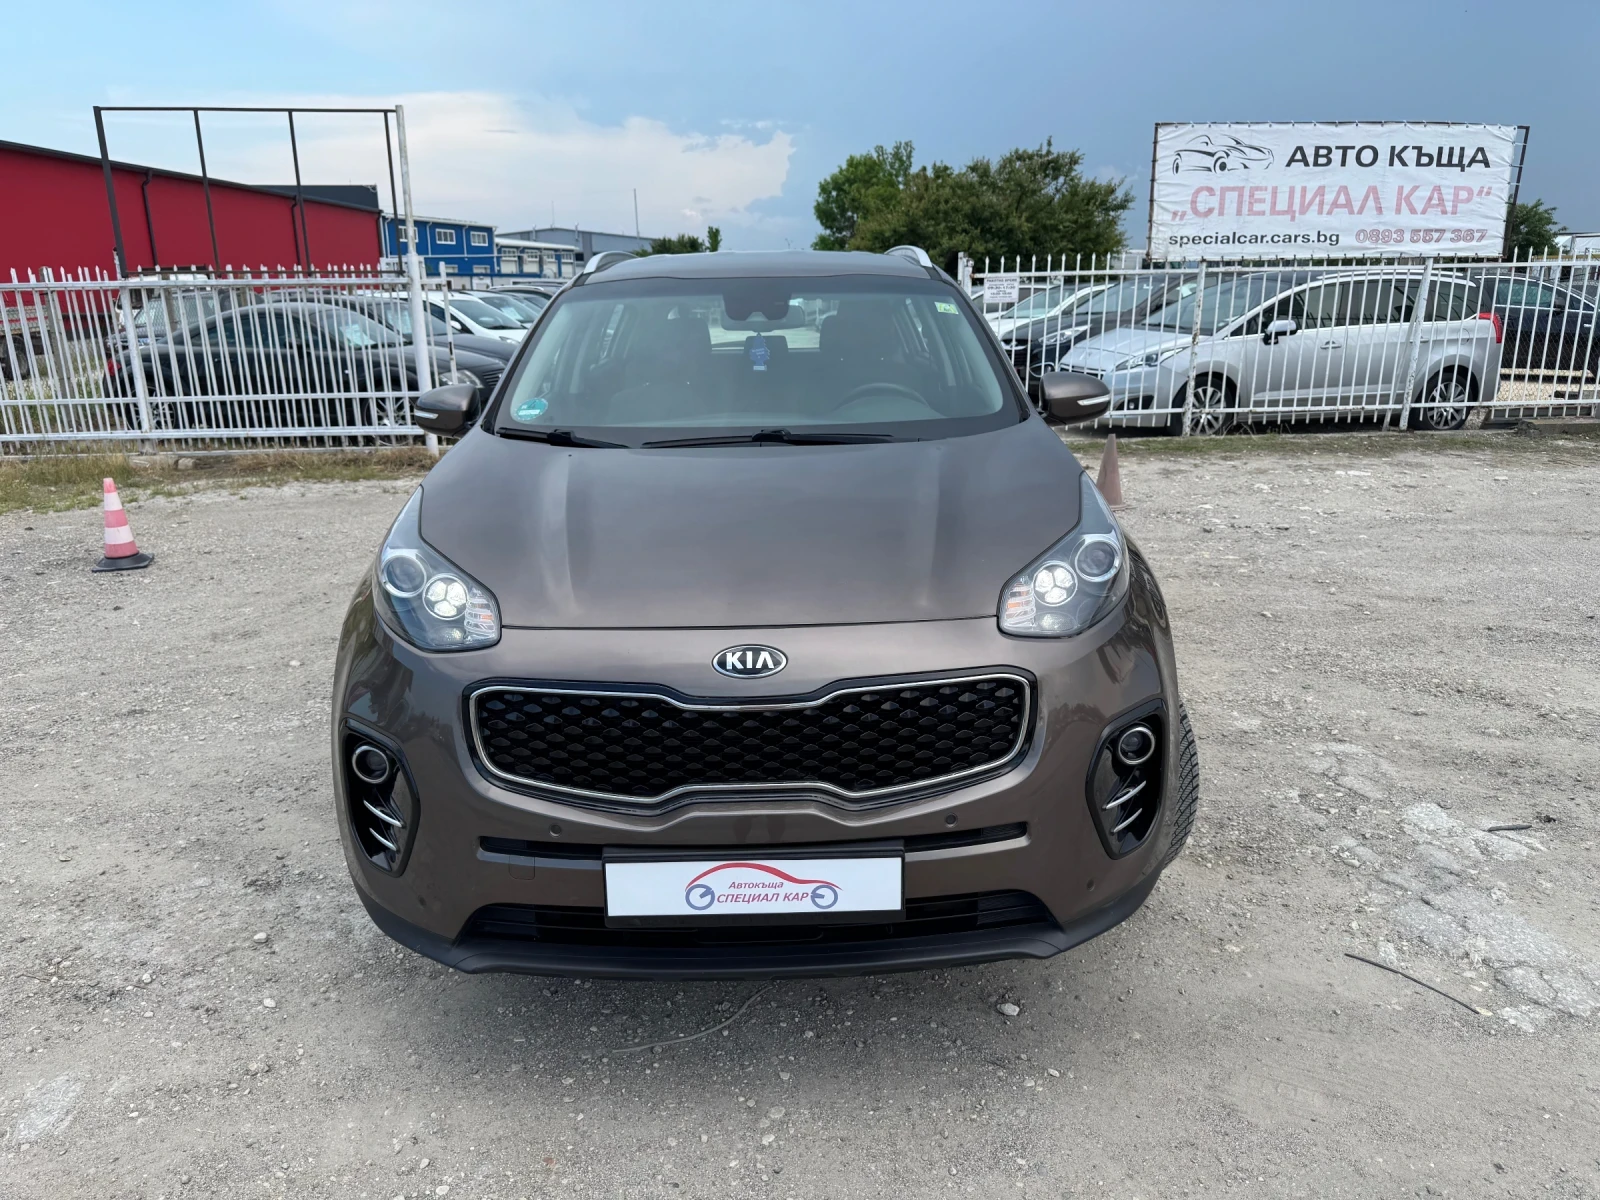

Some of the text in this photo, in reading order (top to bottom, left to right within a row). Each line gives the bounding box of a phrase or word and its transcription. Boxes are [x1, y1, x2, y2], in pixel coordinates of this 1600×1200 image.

[1285, 145, 1492, 172] АВТО КЪЩА
[1168, 230, 1340, 247] specialcar.cars.bg
[1355, 228, 1488, 244] 0893 557 367
[726, 650, 775, 670] KIA
[728, 880, 784, 890] Автокъща
[716, 892, 810, 905] СПЕЦИАЛ КАР
